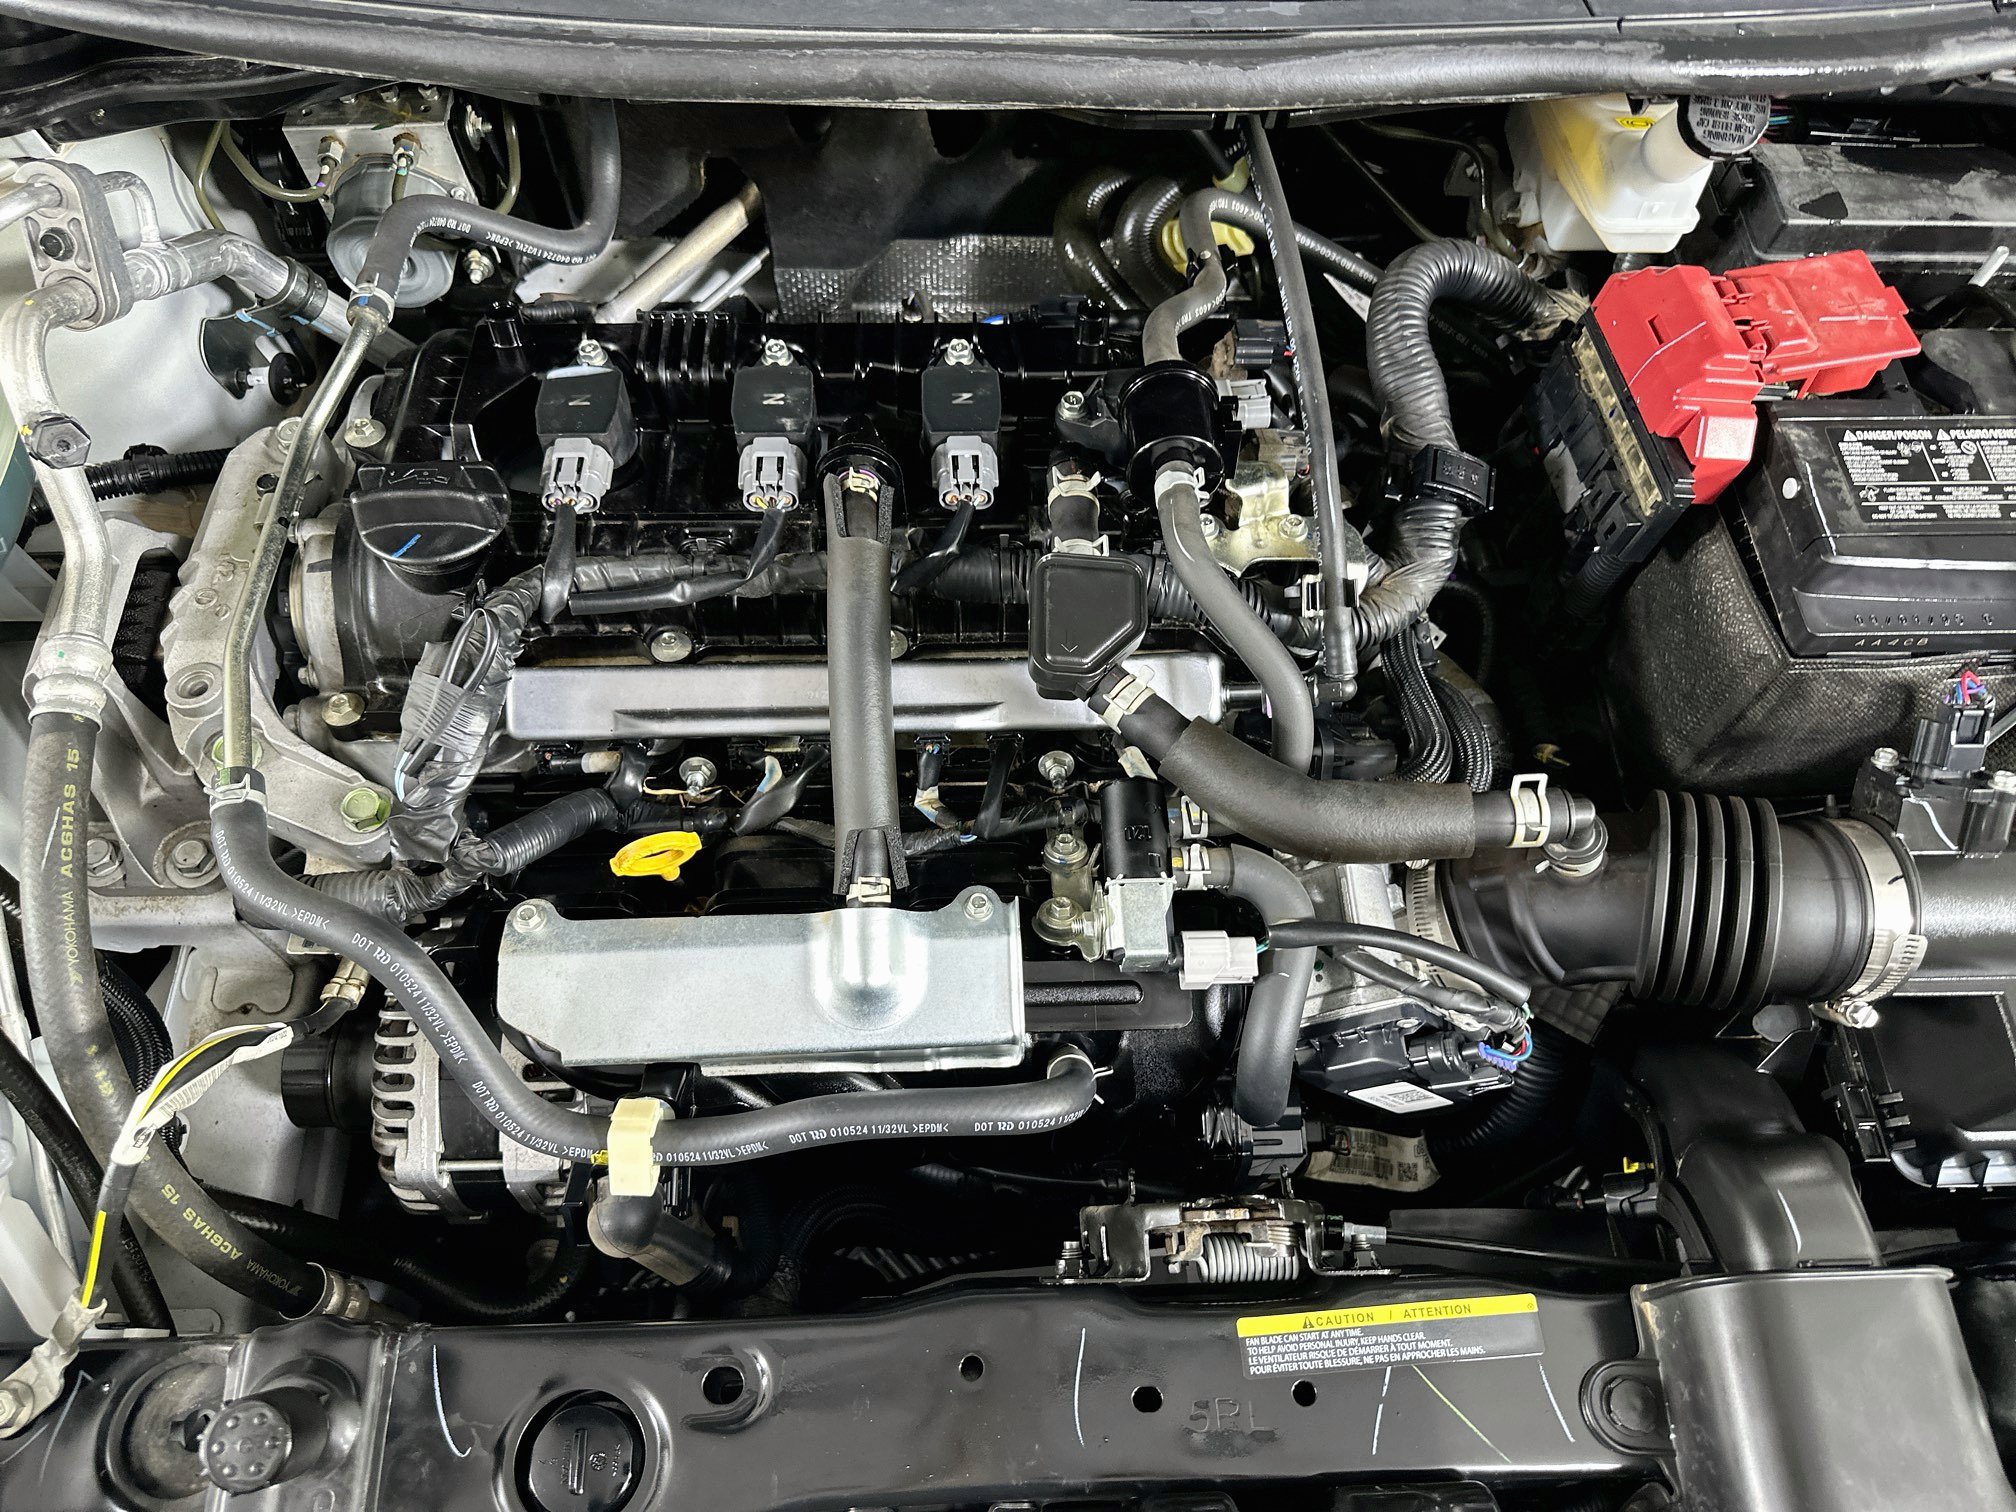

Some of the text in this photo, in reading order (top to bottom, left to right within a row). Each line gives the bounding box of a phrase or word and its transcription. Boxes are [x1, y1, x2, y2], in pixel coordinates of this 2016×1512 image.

[1703, 129, 1745, 144] WARNING
[1856, 429, 1933, 441] DANGER/POISON
[66, 747, 80, 772] 15
[215, 829, 227, 850] DOT
[227, 866, 255, 898] 010524
[291, 907, 331, 931] >EPDM<
[63, 890, 79, 972] YOKOHAMA
[351, 932, 375, 952] DOT
[389, 961, 423, 999] 010524
[439, 1029, 469, 1066] >EPDM<
[472, 1080, 491, 1099] DOT
[495, 1111, 526, 1140] 010524
[561, 1144, 600, 1160] >EPDM
[666, 1151, 702, 1163] 010524
[736, 1140, 770, 1157] >EPDM<
[788, 1131, 808, 1145] DOT
[830, 1124, 869, 1139] 010524
[912, 1122, 949, 1134] >EPDM<
[974, 1121, 994, 1132] DOT
[1018, 1118, 1056, 1131] 010524
[160, 1183, 182, 1206] 15
[246, 1257, 291, 1292] YOKOHAMA
[1315, 1311, 1376, 1328] CAUTION
[1403, 1303, 1472, 1319] ATTENTION
[1245, 1336, 1260, 1347] FAN
[1260, 1334, 1284, 1346] BLADE
[1283, 1333, 1299, 1344] CAN
[1299, 1331, 1320, 1342] START
[1320, 1330, 1330, 1340] AT
[1330, 1329, 1346, 1340] ANY
[1246, 1345, 1258, 1356] TO
[1258, 1343, 1276, 1355] HELP
[1276, 1341, 1299, 1354] AVOID
[1298, 1338, 1335, 1352] PERSONAL
[1360, 1335, 1377, 1347] KEEP
[1377, 1333, 1402, 1345] HANDS
[1402, 1331, 1427, 1342] CLEAR.
[1248, 1355, 1258, 1366] LE
[1258, 1351, 1308, 1365] VENTILATEUR
[1308, 1348, 1336, 1360] RISQUE
[1336, 1347, 1348, 1358] DE
[1348, 1343, 1390, 1357] DÉMARRER
[1395, 1340, 1417, 1352] TOUT
[1417, 1338, 1454, 1350] MOMENT.
[1249, 1364, 1272, 1376] POUR
[1272, 1359, 1299, 1374] ÉVITER
[1298, 1358, 1324, 1371] TOUTE
[1363, 1354, 1375, 1365] NE
[1375, 1352, 1390, 1364] PAS
[1389, 1351, 1401, 1363] EN
[1401, 1348, 1447, 1362] APPROCHER
[1446, 1346, 1460, 1358] LES
[1459, 1345, 1486, 1357] MAINS.
